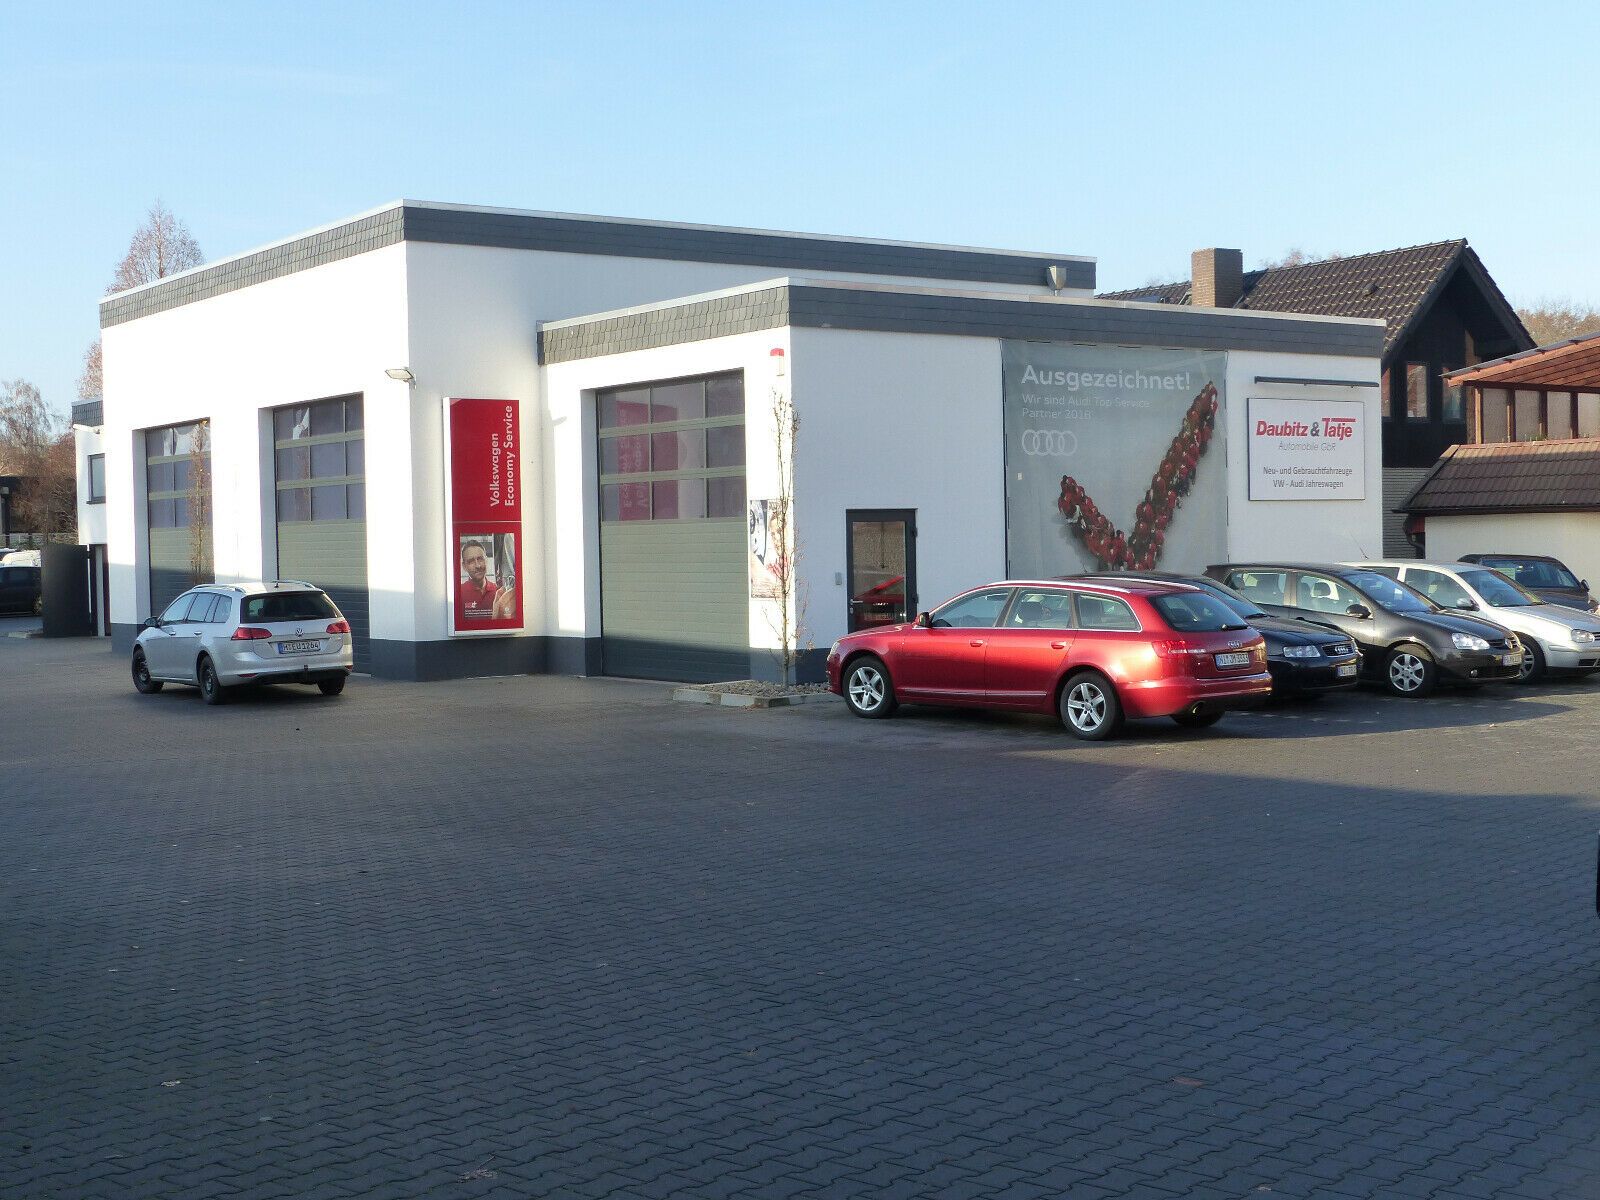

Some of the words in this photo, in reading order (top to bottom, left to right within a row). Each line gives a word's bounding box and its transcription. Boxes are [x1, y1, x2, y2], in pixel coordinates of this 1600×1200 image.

[1021, 364, 1191, 392] Ausgezeichnet!
[1022, 394, 1041, 405] Wir
[1043, 394, 1066, 406] sind
[1068, 395, 1091, 407] Audi
[1022, 407, 1062, 419] Partner
[503, 405, 514, 449] Service
[1256, 420, 1309, 437] Daubitz
[1310, 421, 1320, 437] &
[1321, 417, 1356, 441] Tatje
[1279, 441, 1319, 452] Automobile
[489, 433, 501, 507] Volkswagen
[504, 451, 516, 507] Economy
[1263, 466, 1279, 475] Neu-
[1279, 466, 1292, 475] und
[1293, 466, 1353, 477] Gebrauchtfahrzeuge
[1273, 479, 1285, 488] VW
[1290, 479, 1304, 488] Audi
[1305, 479, 1344, 490] Jahreswagen
